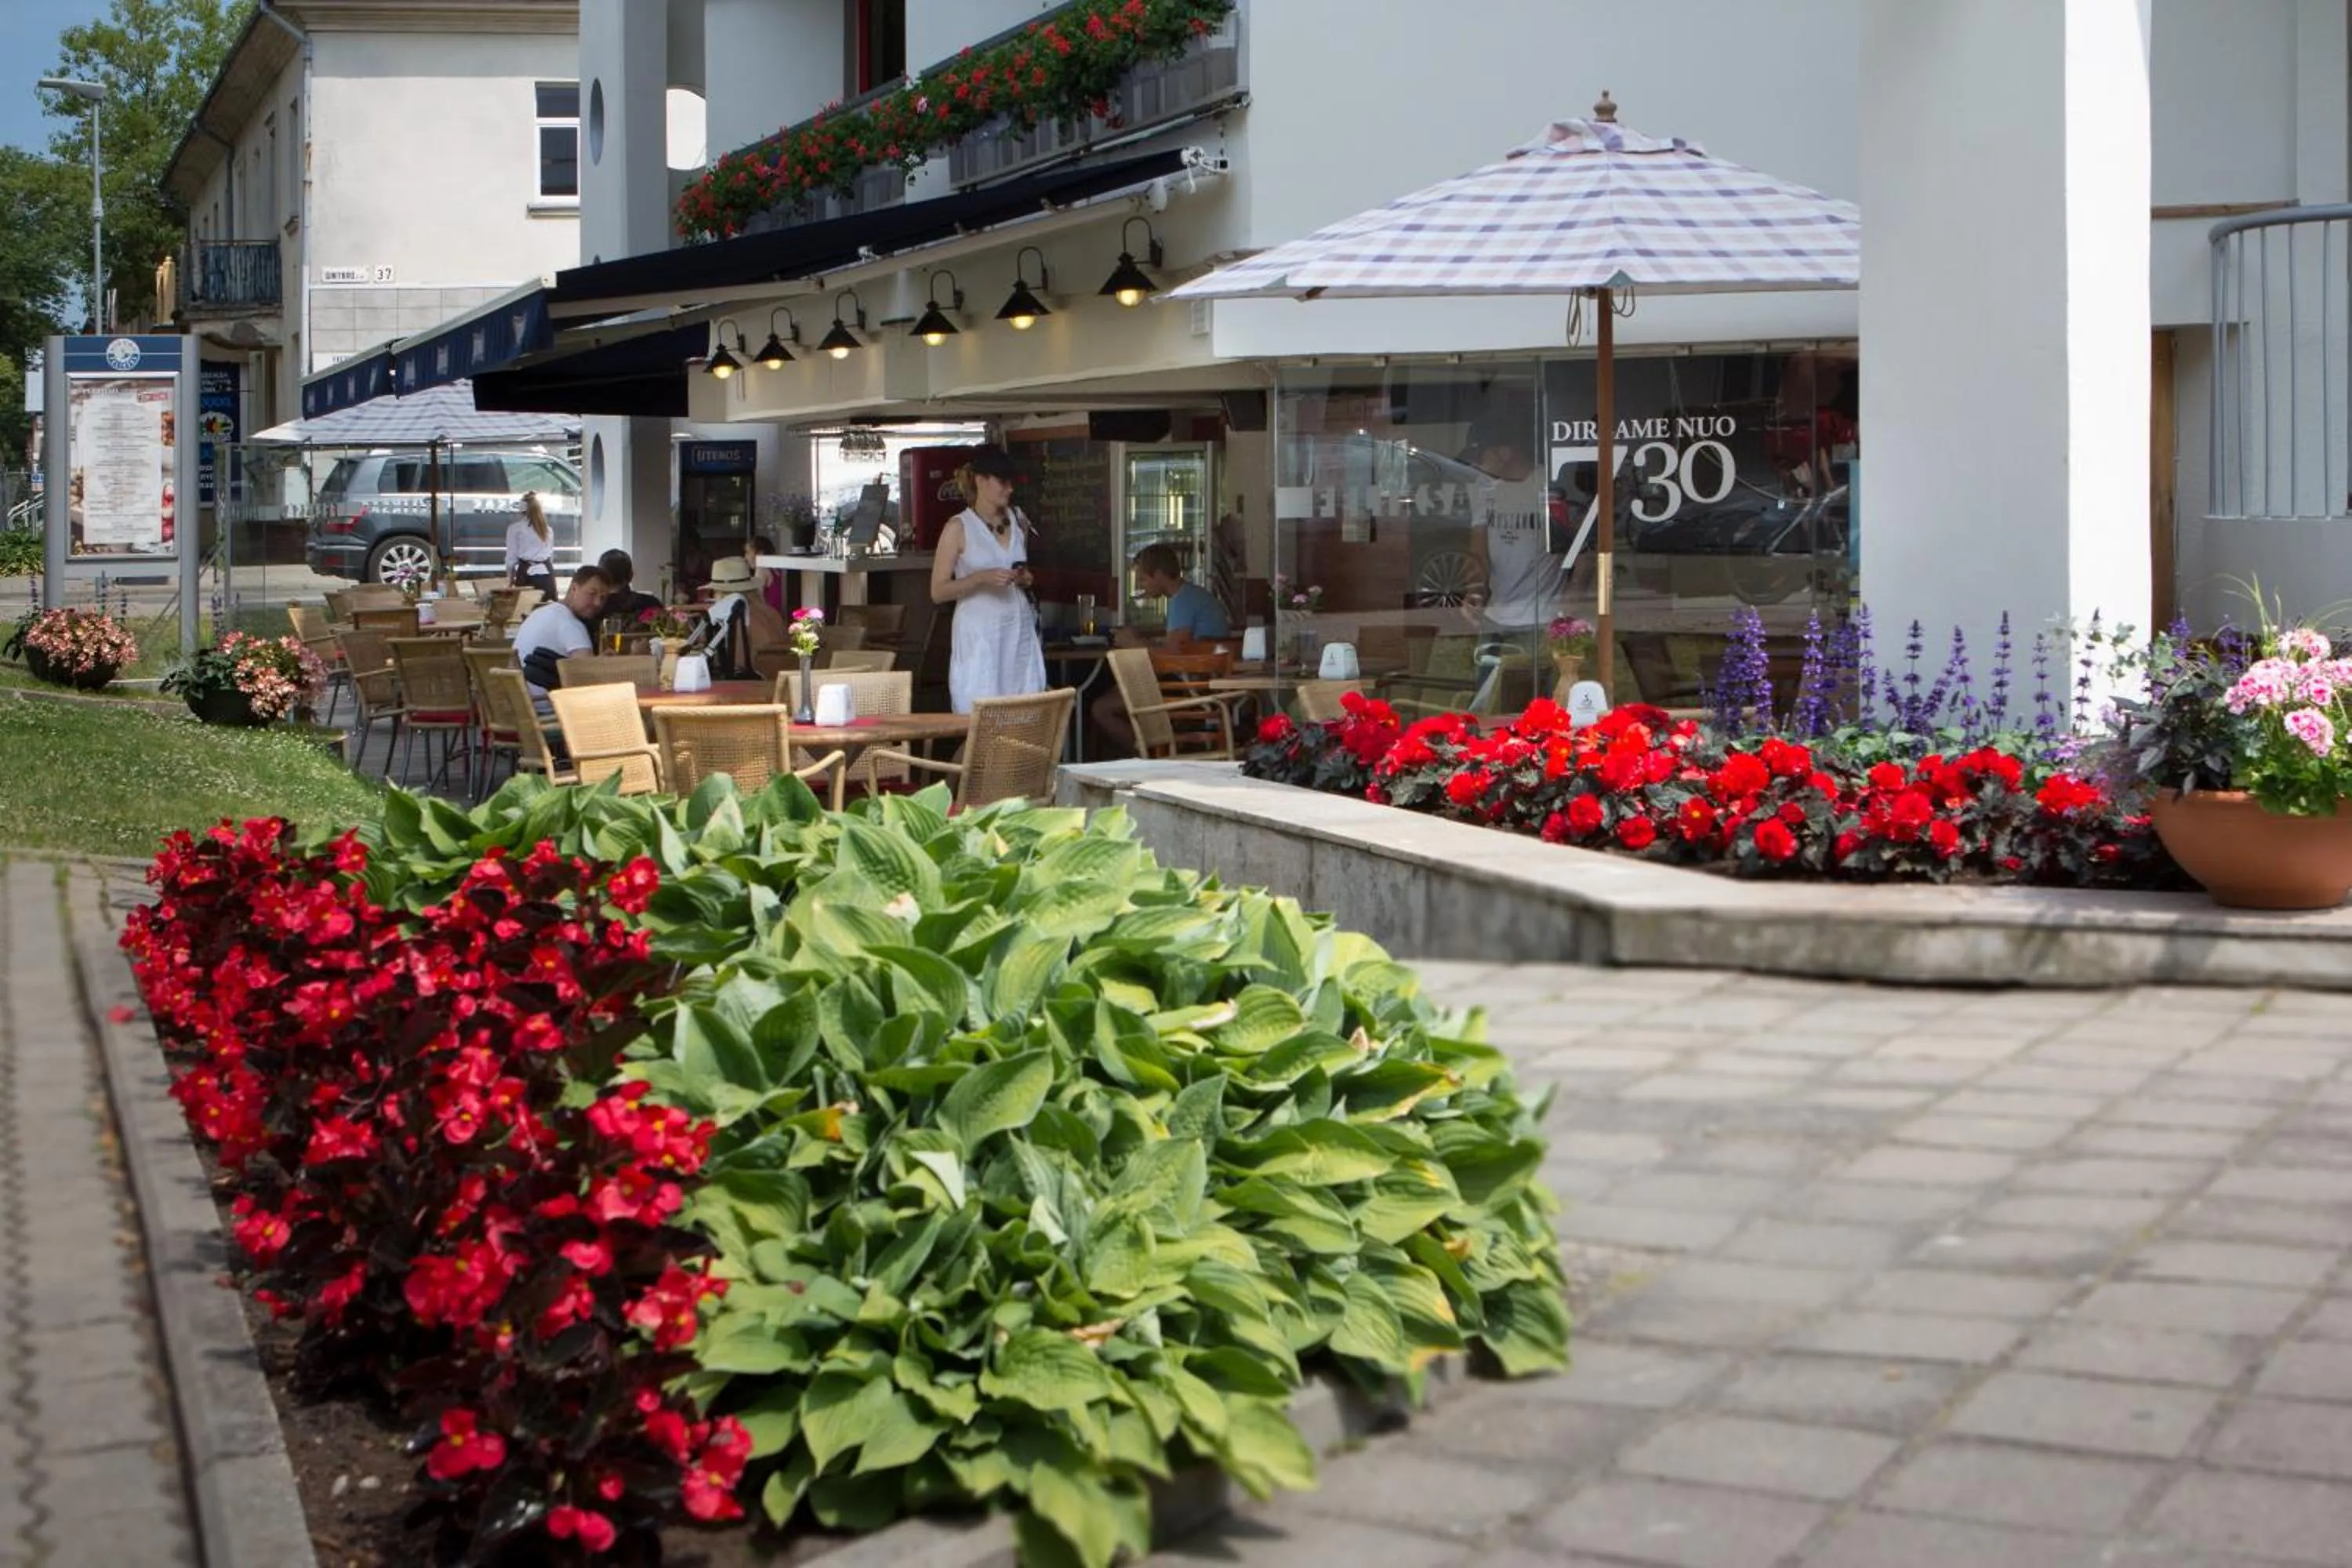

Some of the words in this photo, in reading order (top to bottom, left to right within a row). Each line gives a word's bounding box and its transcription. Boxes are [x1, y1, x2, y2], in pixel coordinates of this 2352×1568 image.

[377, 268, 392, 280] 37
[1552, 418, 1669, 441] DIRAME
[1675, 416, 1737, 438] NUO
